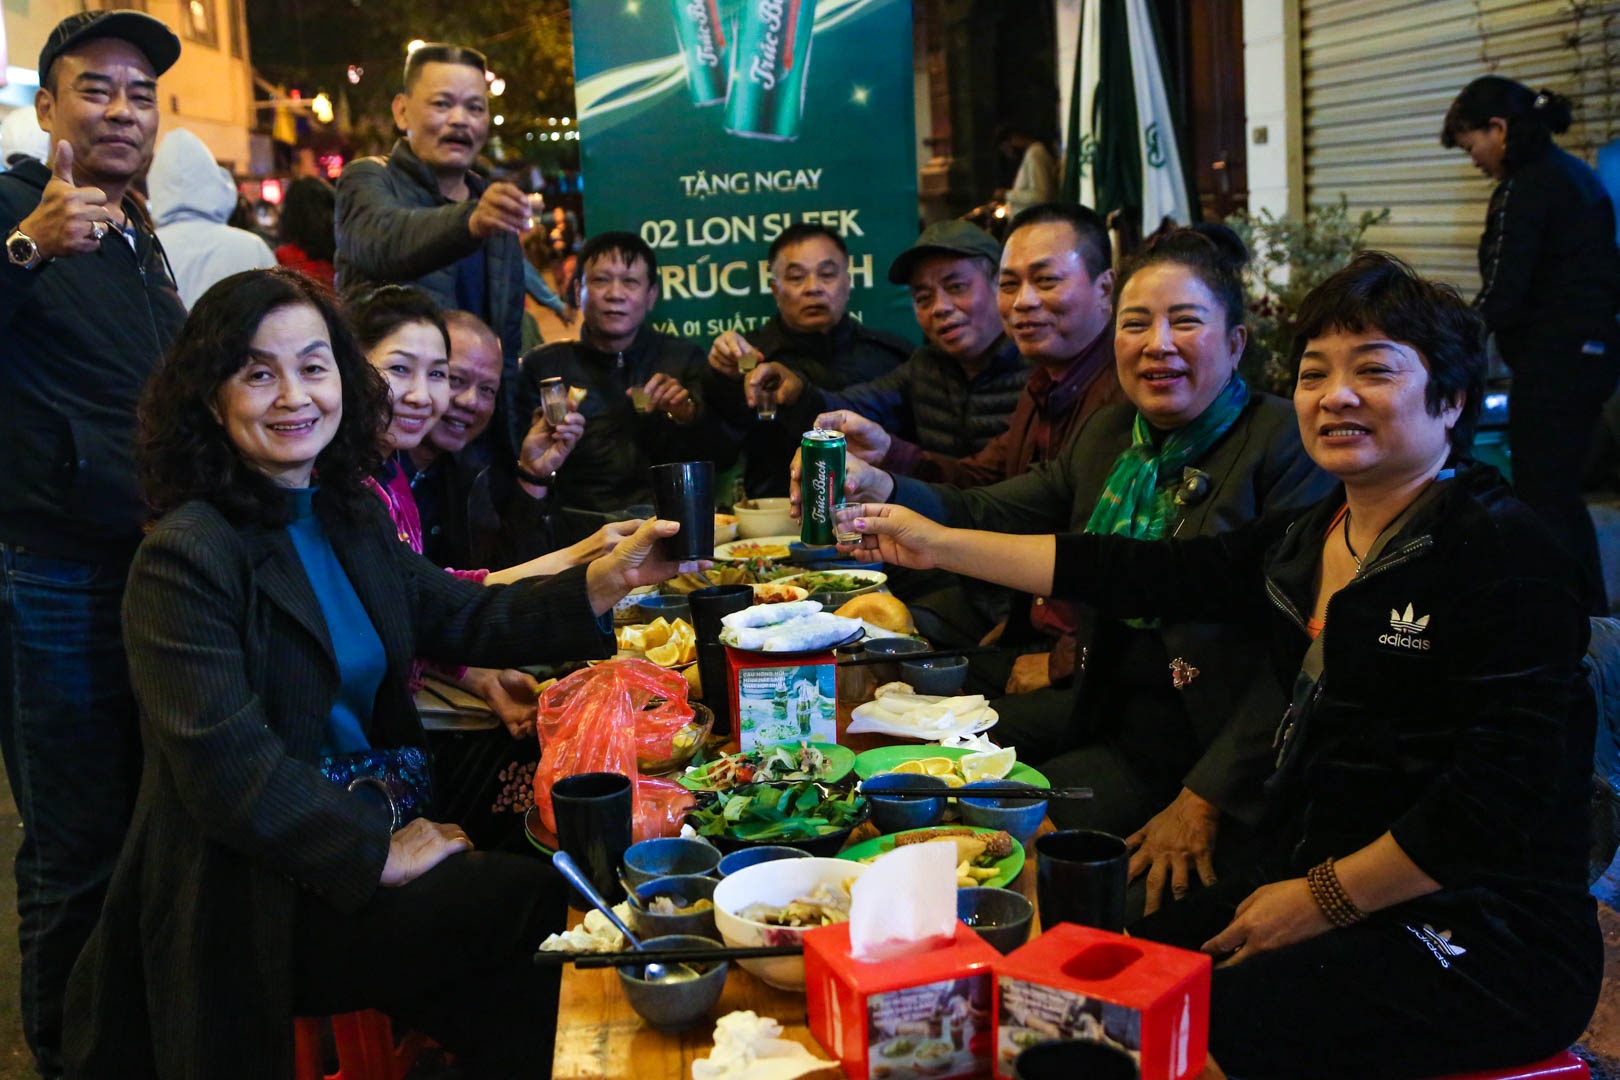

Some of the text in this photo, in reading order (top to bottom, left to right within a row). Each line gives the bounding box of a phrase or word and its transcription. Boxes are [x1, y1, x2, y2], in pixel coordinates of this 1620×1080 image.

[750, 32, 779, 90] Trúc
[680, 168, 822, 200] TẶNG NGAY
[641, 220, 679, 248] 02
[686, 215, 756, 246] LON
[656, 255, 751, 300] RÚC
[683, 320, 700, 337] 01
[812, 494, 827, 524] Trúc
[1379, 633, 1431, 650] adidas
